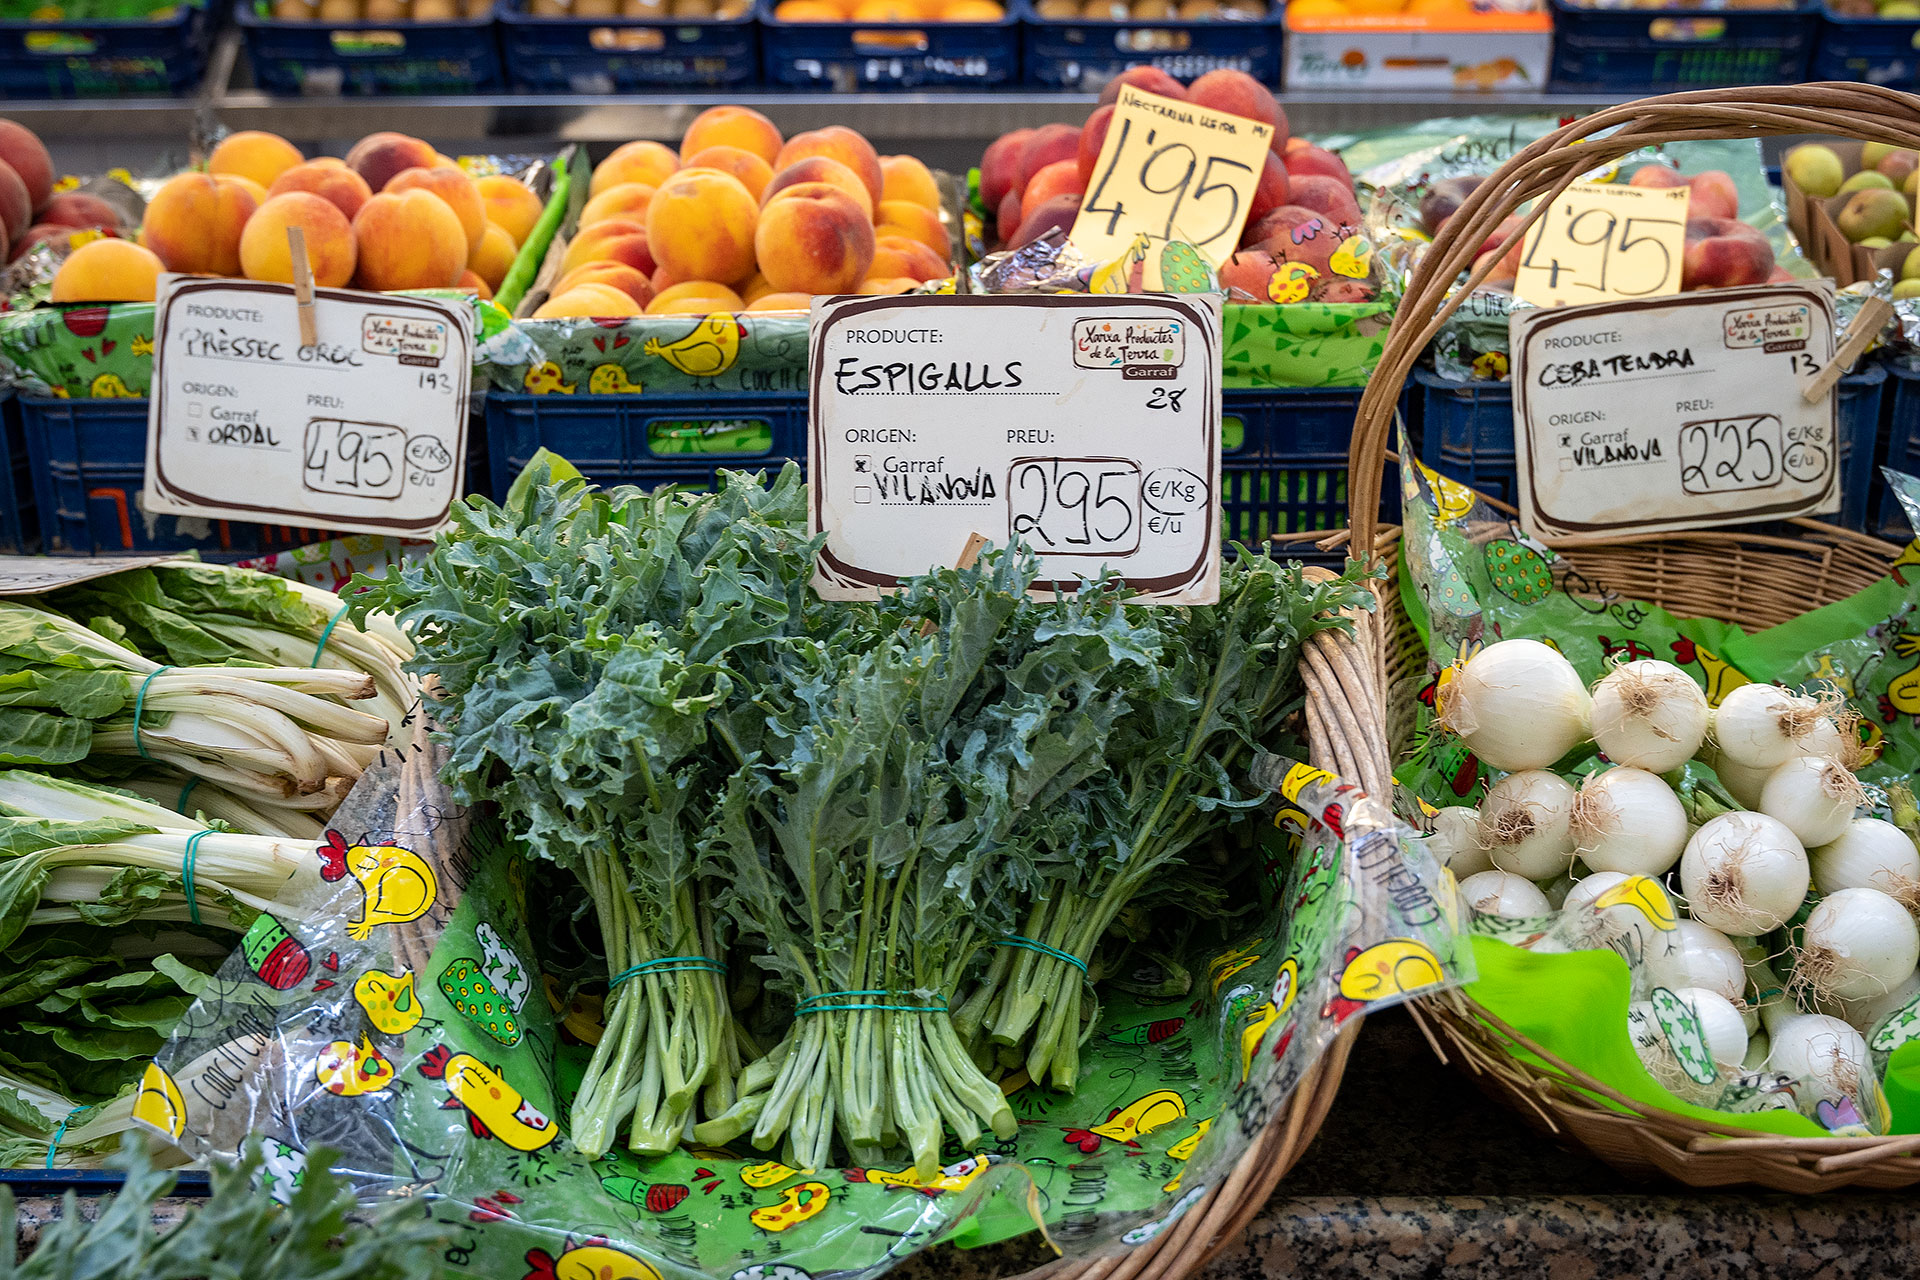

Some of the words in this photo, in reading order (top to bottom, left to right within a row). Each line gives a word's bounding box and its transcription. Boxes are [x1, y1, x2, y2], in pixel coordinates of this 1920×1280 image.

[1085, 118, 1254, 246] 4'95
[1522, 204, 1683, 296] 4'95
[187, 304, 263, 323] PRODUCTE:
[845, 329, 943, 344] PRODUCTE:
[1084, 326, 1121, 345] Xarxa
[1125, 325, 1174, 344] Productes
[1544, 331, 1622, 350] PRODUCTE:
[1090, 347, 1102, 359] de
[1104, 347, 1116, 359] la
[1118, 346, 1160, 361] Terra
[1126, 366, 1175, 378] Garraf
[1790, 353, 1821, 377] 13
[835, 357, 1023, 394] ESPIGALLS
[182, 381, 239, 397] ORIGEN:
[307, 393, 344, 409] PREU:
[1146, 387, 1186, 412] 28
[1676, 399, 1714, 413] PREU:
[210, 405, 257, 421] Garraf
[1549, 410, 1606, 426] ORIGEN:
[208, 422, 280, 447] ORDAL
[845, 429, 917, 443] ORIGEN:
[1007, 429, 1055, 443] PREU:
[1580, 428, 1629, 445] Garraf
[1787, 425, 1824, 441] €/Kg
[1573, 438, 1661, 467] VILANOVA
[1788, 454, 1814, 468] €/u
[883, 456, 945, 474] Garraf
[409, 471, 435, 487] €/u
[873, 466, 996, 505] VILANOVA
[1148, 480, 1195, 502] €/Kg
[1148, 517, 1182, 534] €/u
